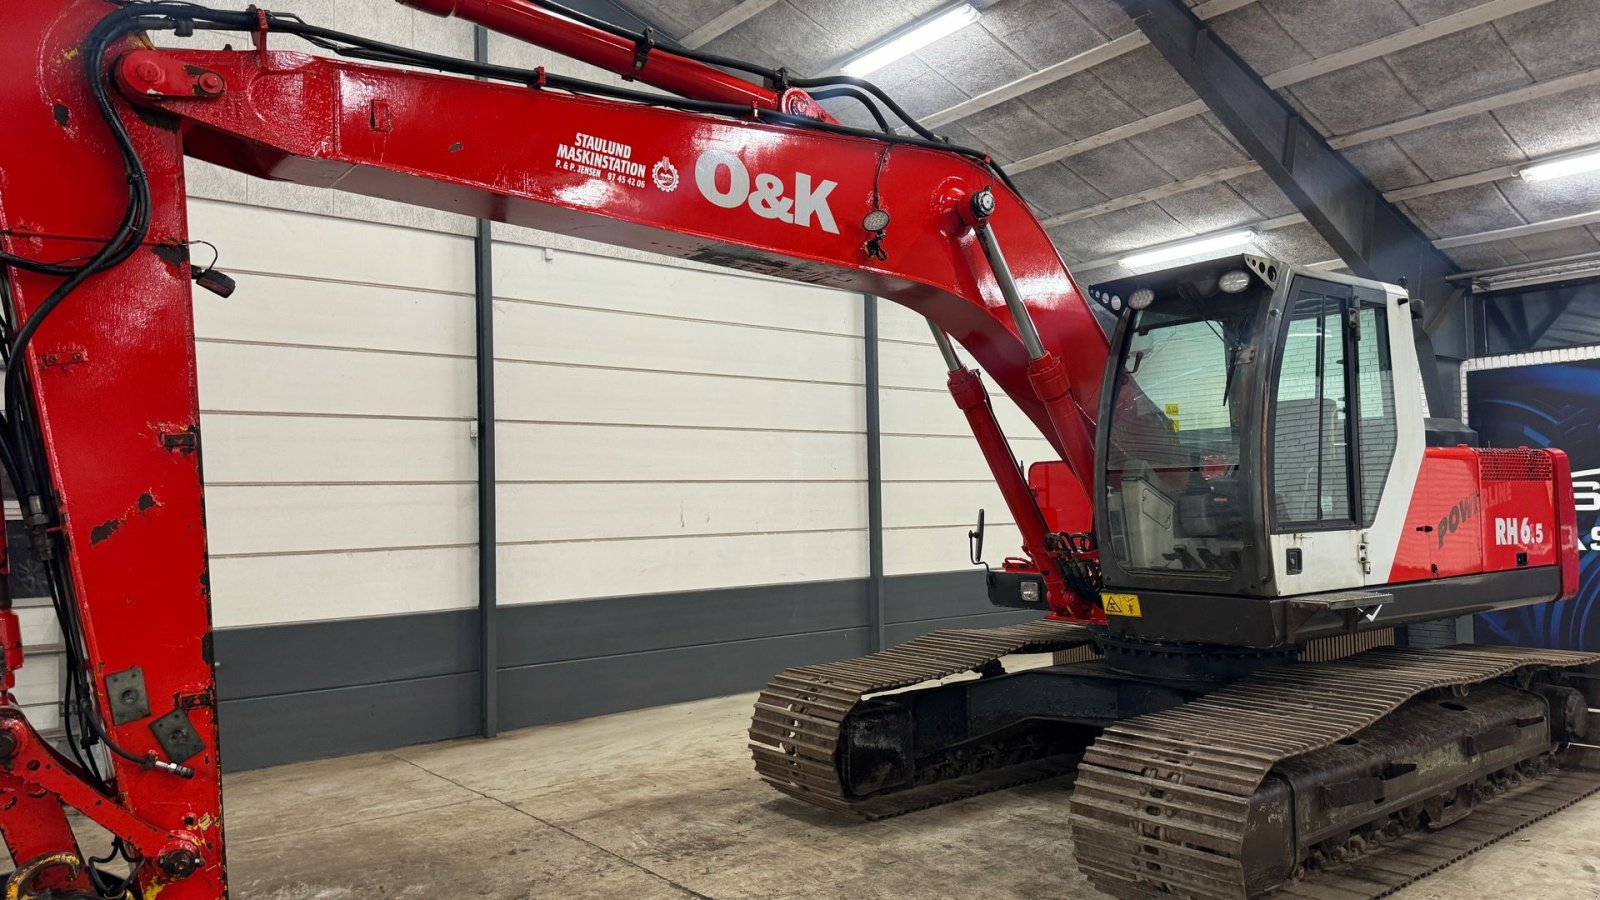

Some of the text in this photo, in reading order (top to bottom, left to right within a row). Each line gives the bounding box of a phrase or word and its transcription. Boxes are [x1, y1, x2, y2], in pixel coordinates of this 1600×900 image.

[575, 132, 631, 158] STAULUND
[556, 160, 601, 178] P. & P. JENSEN
[557, 144, 646, 178] MASKINSTATION
[607, 172, 616, 182] 97
[618, 175, 626, 184] 45
[627, 178, 636, 186] 42
[695, 150, 840, 234] O&K
